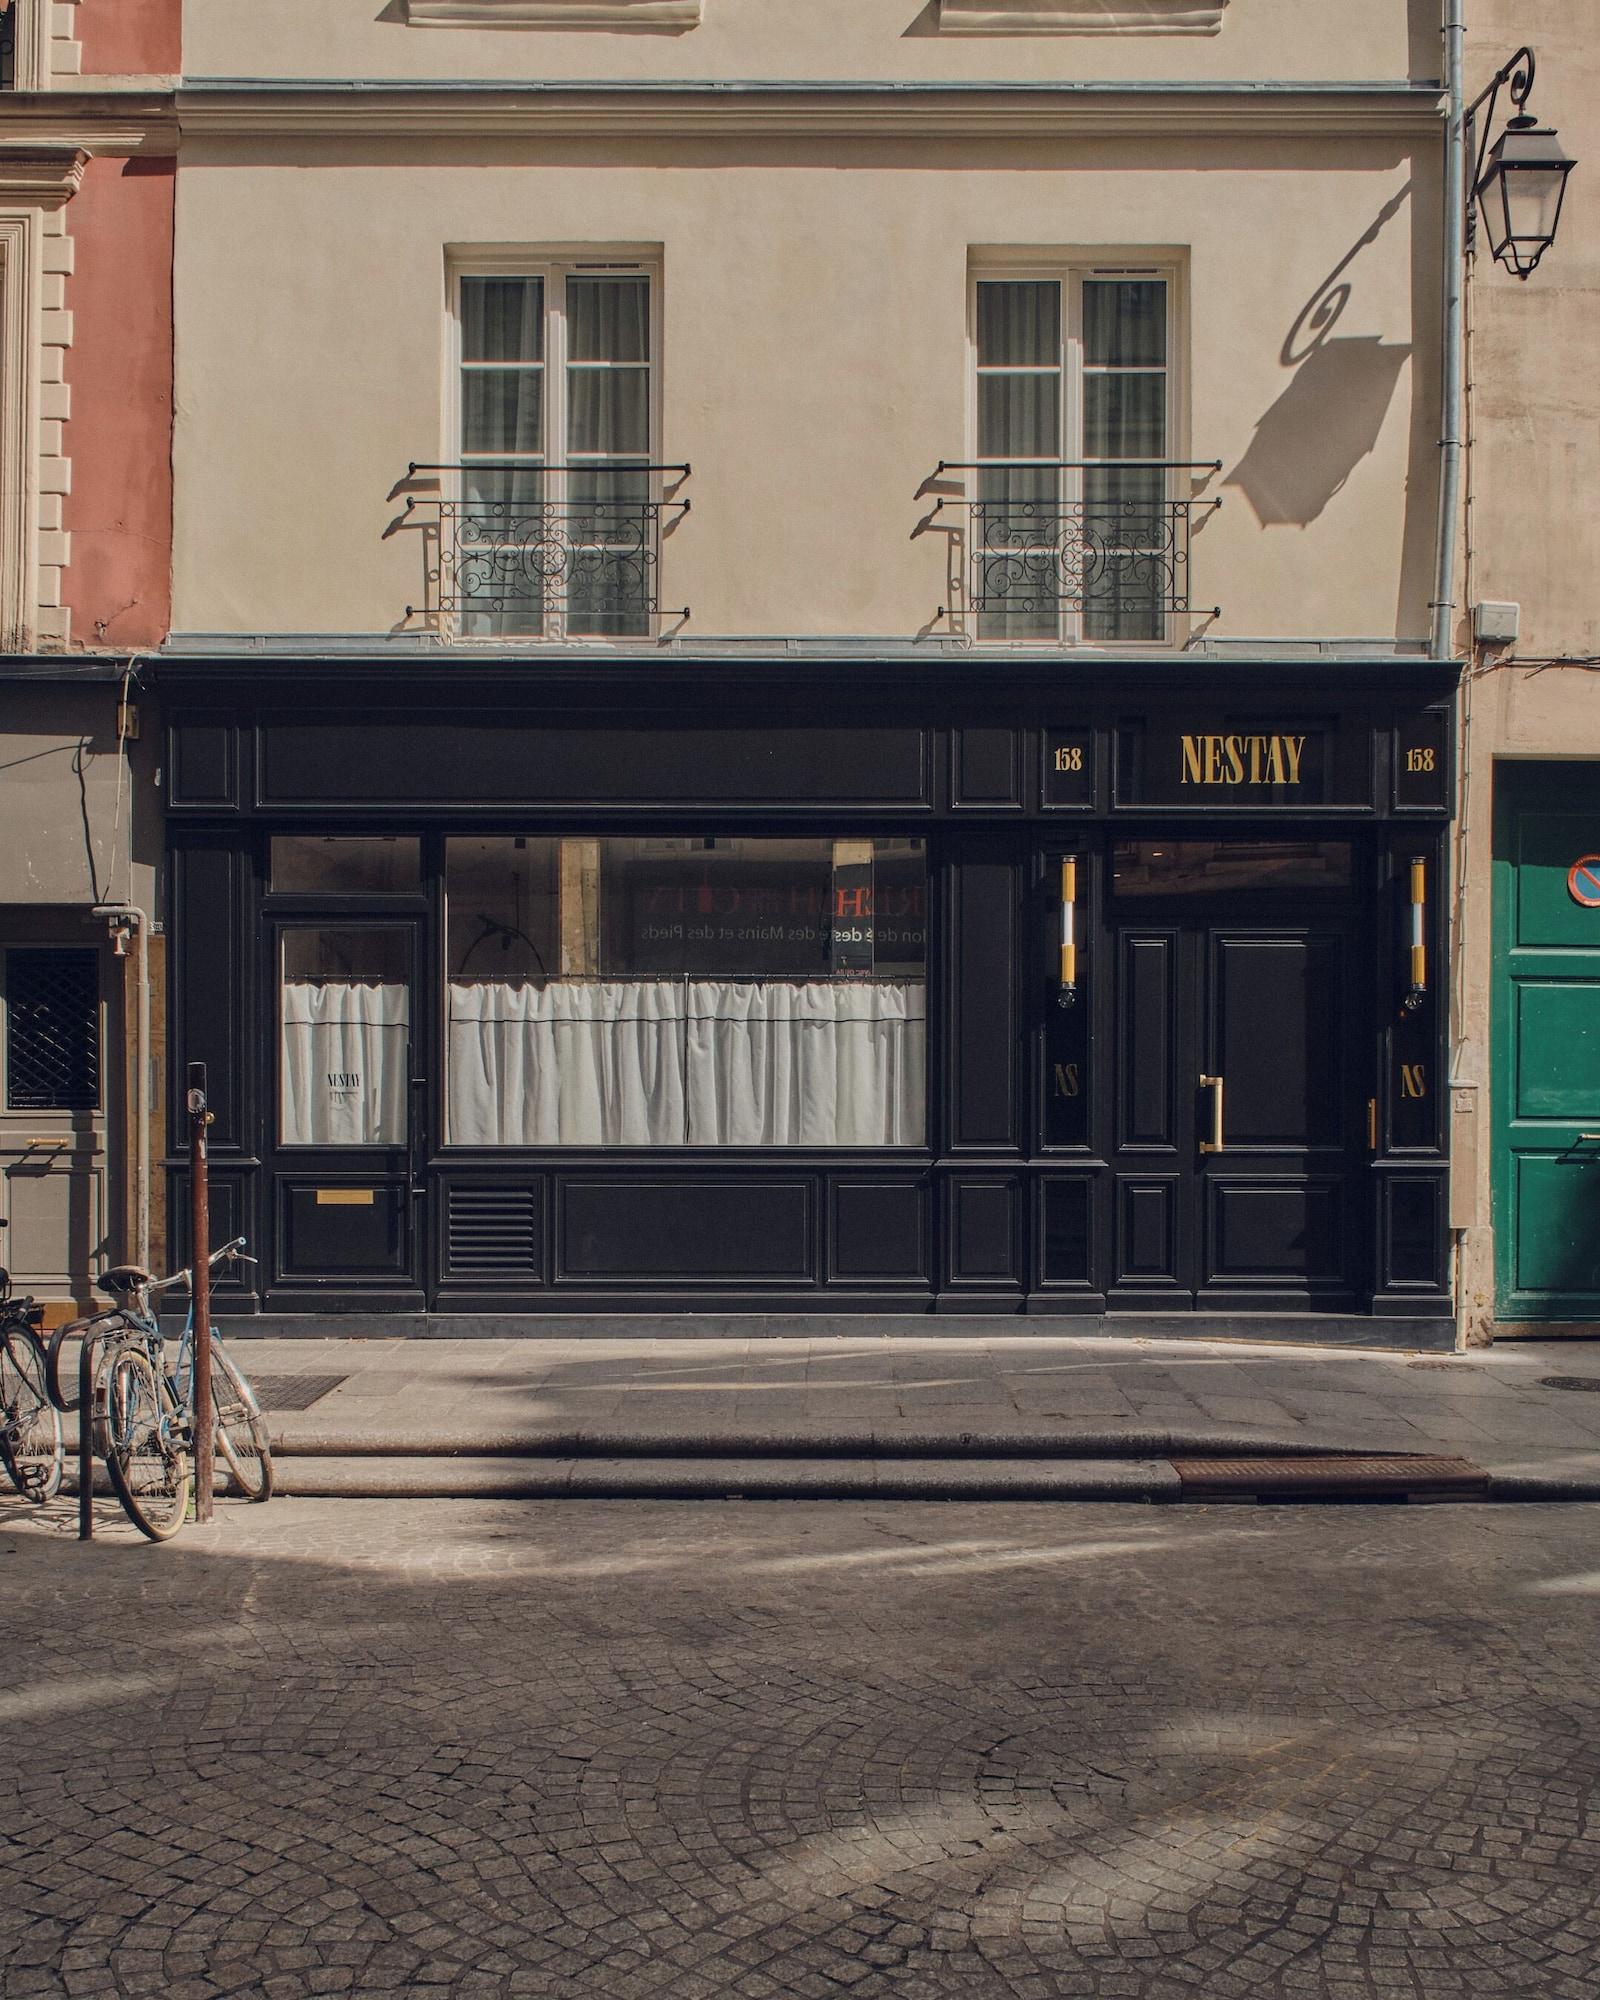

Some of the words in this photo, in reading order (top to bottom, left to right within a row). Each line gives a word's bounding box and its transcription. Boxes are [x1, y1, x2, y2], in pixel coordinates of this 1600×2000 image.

[1054, 746, 1083, 772] 158
[1180, 735, 1306, 785] NESTAY
[1406, 747, 1436, 773] 158
[1053, 1063, 1079, 1097] NS
[1400, 1064, 1425, 1098] NS
